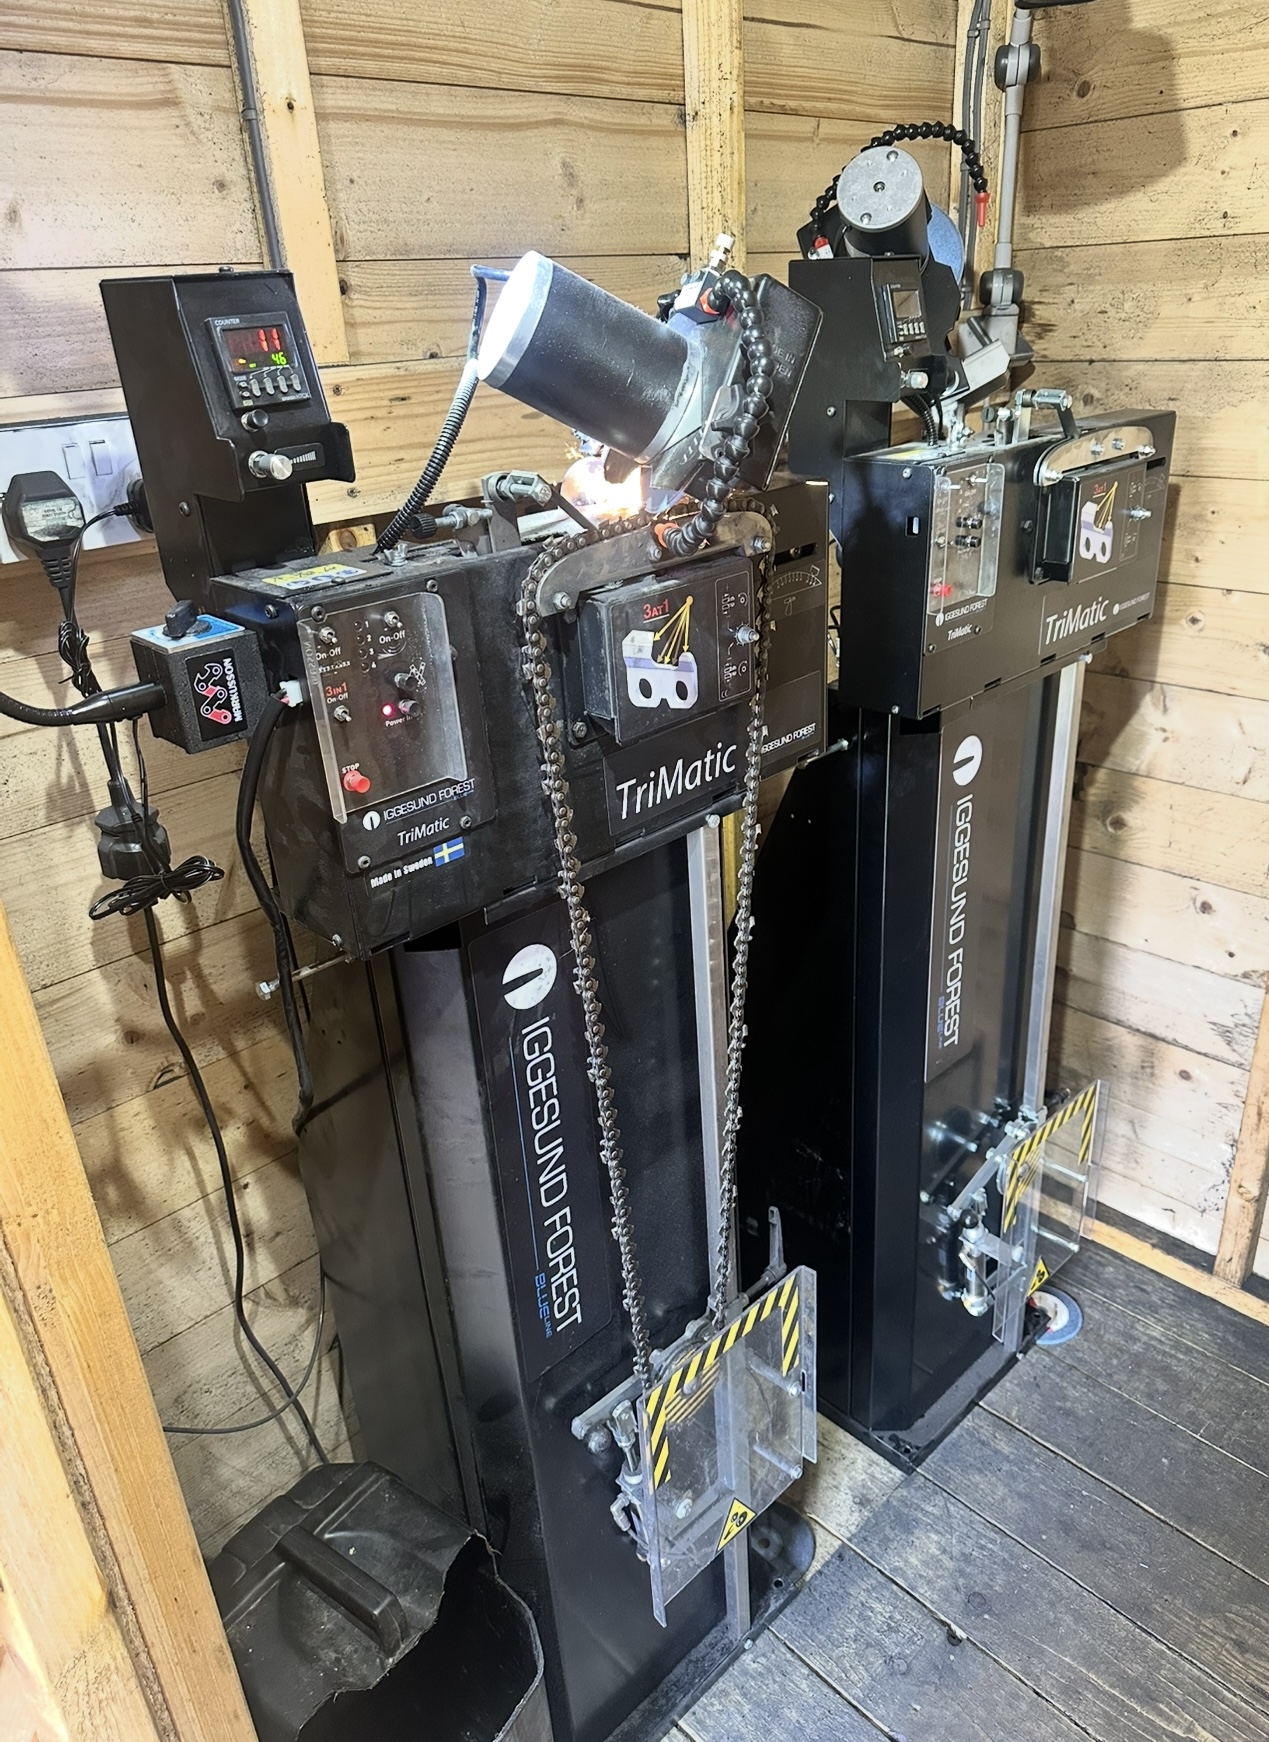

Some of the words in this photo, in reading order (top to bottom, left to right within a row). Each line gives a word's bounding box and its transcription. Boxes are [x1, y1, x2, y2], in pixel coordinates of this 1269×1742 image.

[215, 318, 240, 326] COUNTER
[259, 328, 281, 352] 11
[271, 352, 287, 365] 46
[643, 598, 669, 620] 3AT1
[969, 598, 988, 612] FOREST
[365, 620, 370, 628] 1
[1045, 596, 1109, 645] TriMatic
[366, 634, 372, 642] 2
[379, 629, 406, 644] On-Off
[947, 623, 973, 641] TriMatic
[315, 647, 341, 660] On-Off
[222, 657, 243, 723] MARKUSSON
[325, 682, 348, 697] 3IN1
[326, 692, 349, 704] On-Off
[793, 722, 817, 740] FOREST
[342, 763, 360, 774] STOP
[616, 742, 737, 820] TriMatic
[383, 793, 437, 821] IGGESUND
[439, 778, 475, 801] FOREST
[397, 817, 450, 846] TriMatic
[371, 872, 393, 888] Made
[403, 856, 433, 875] Sweden
[949, 793, 973, 945] IGGESUND
[943, 947, 964, 1047] FOREST
[521, 1016, 569, 1208] IGGESUND
[543, 1209, 582, 1332] FOREST
